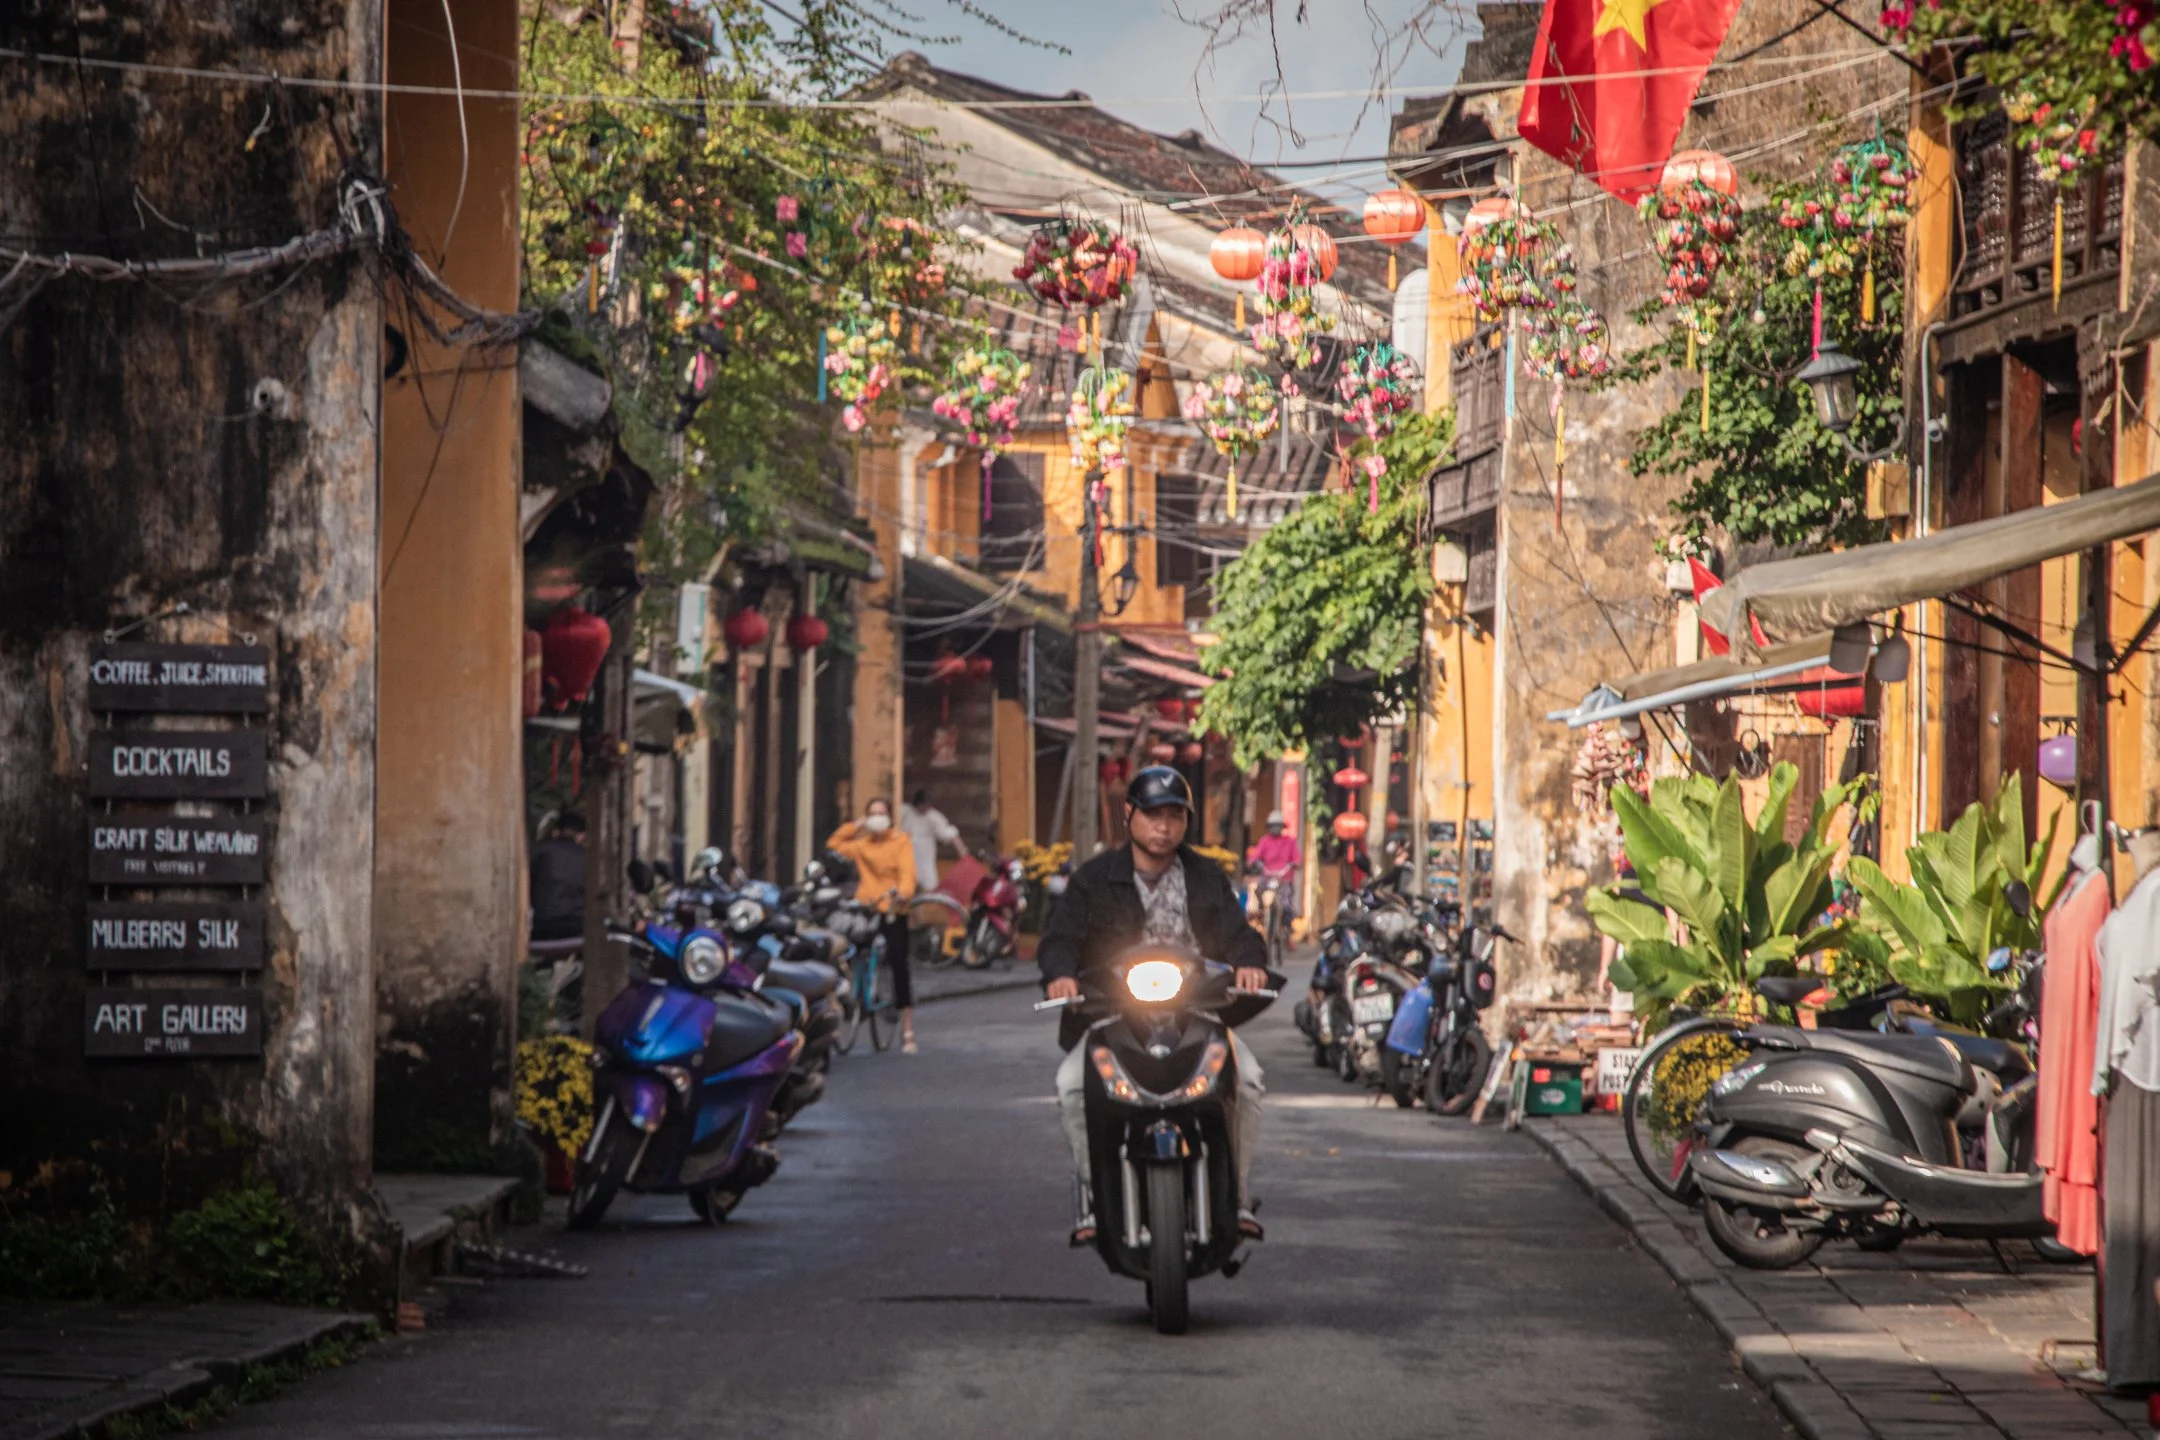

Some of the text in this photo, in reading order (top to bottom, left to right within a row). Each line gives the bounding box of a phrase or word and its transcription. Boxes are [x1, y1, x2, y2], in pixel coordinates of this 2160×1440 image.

[113, 746, 231, 777] COCKTAILS
[94, 827, 259, 855] CRAFT SILK WEAVING
[92, 919, 239, 949] MULBERRY SILK
[93, 1003, 247, 1035] ART GALLERY
